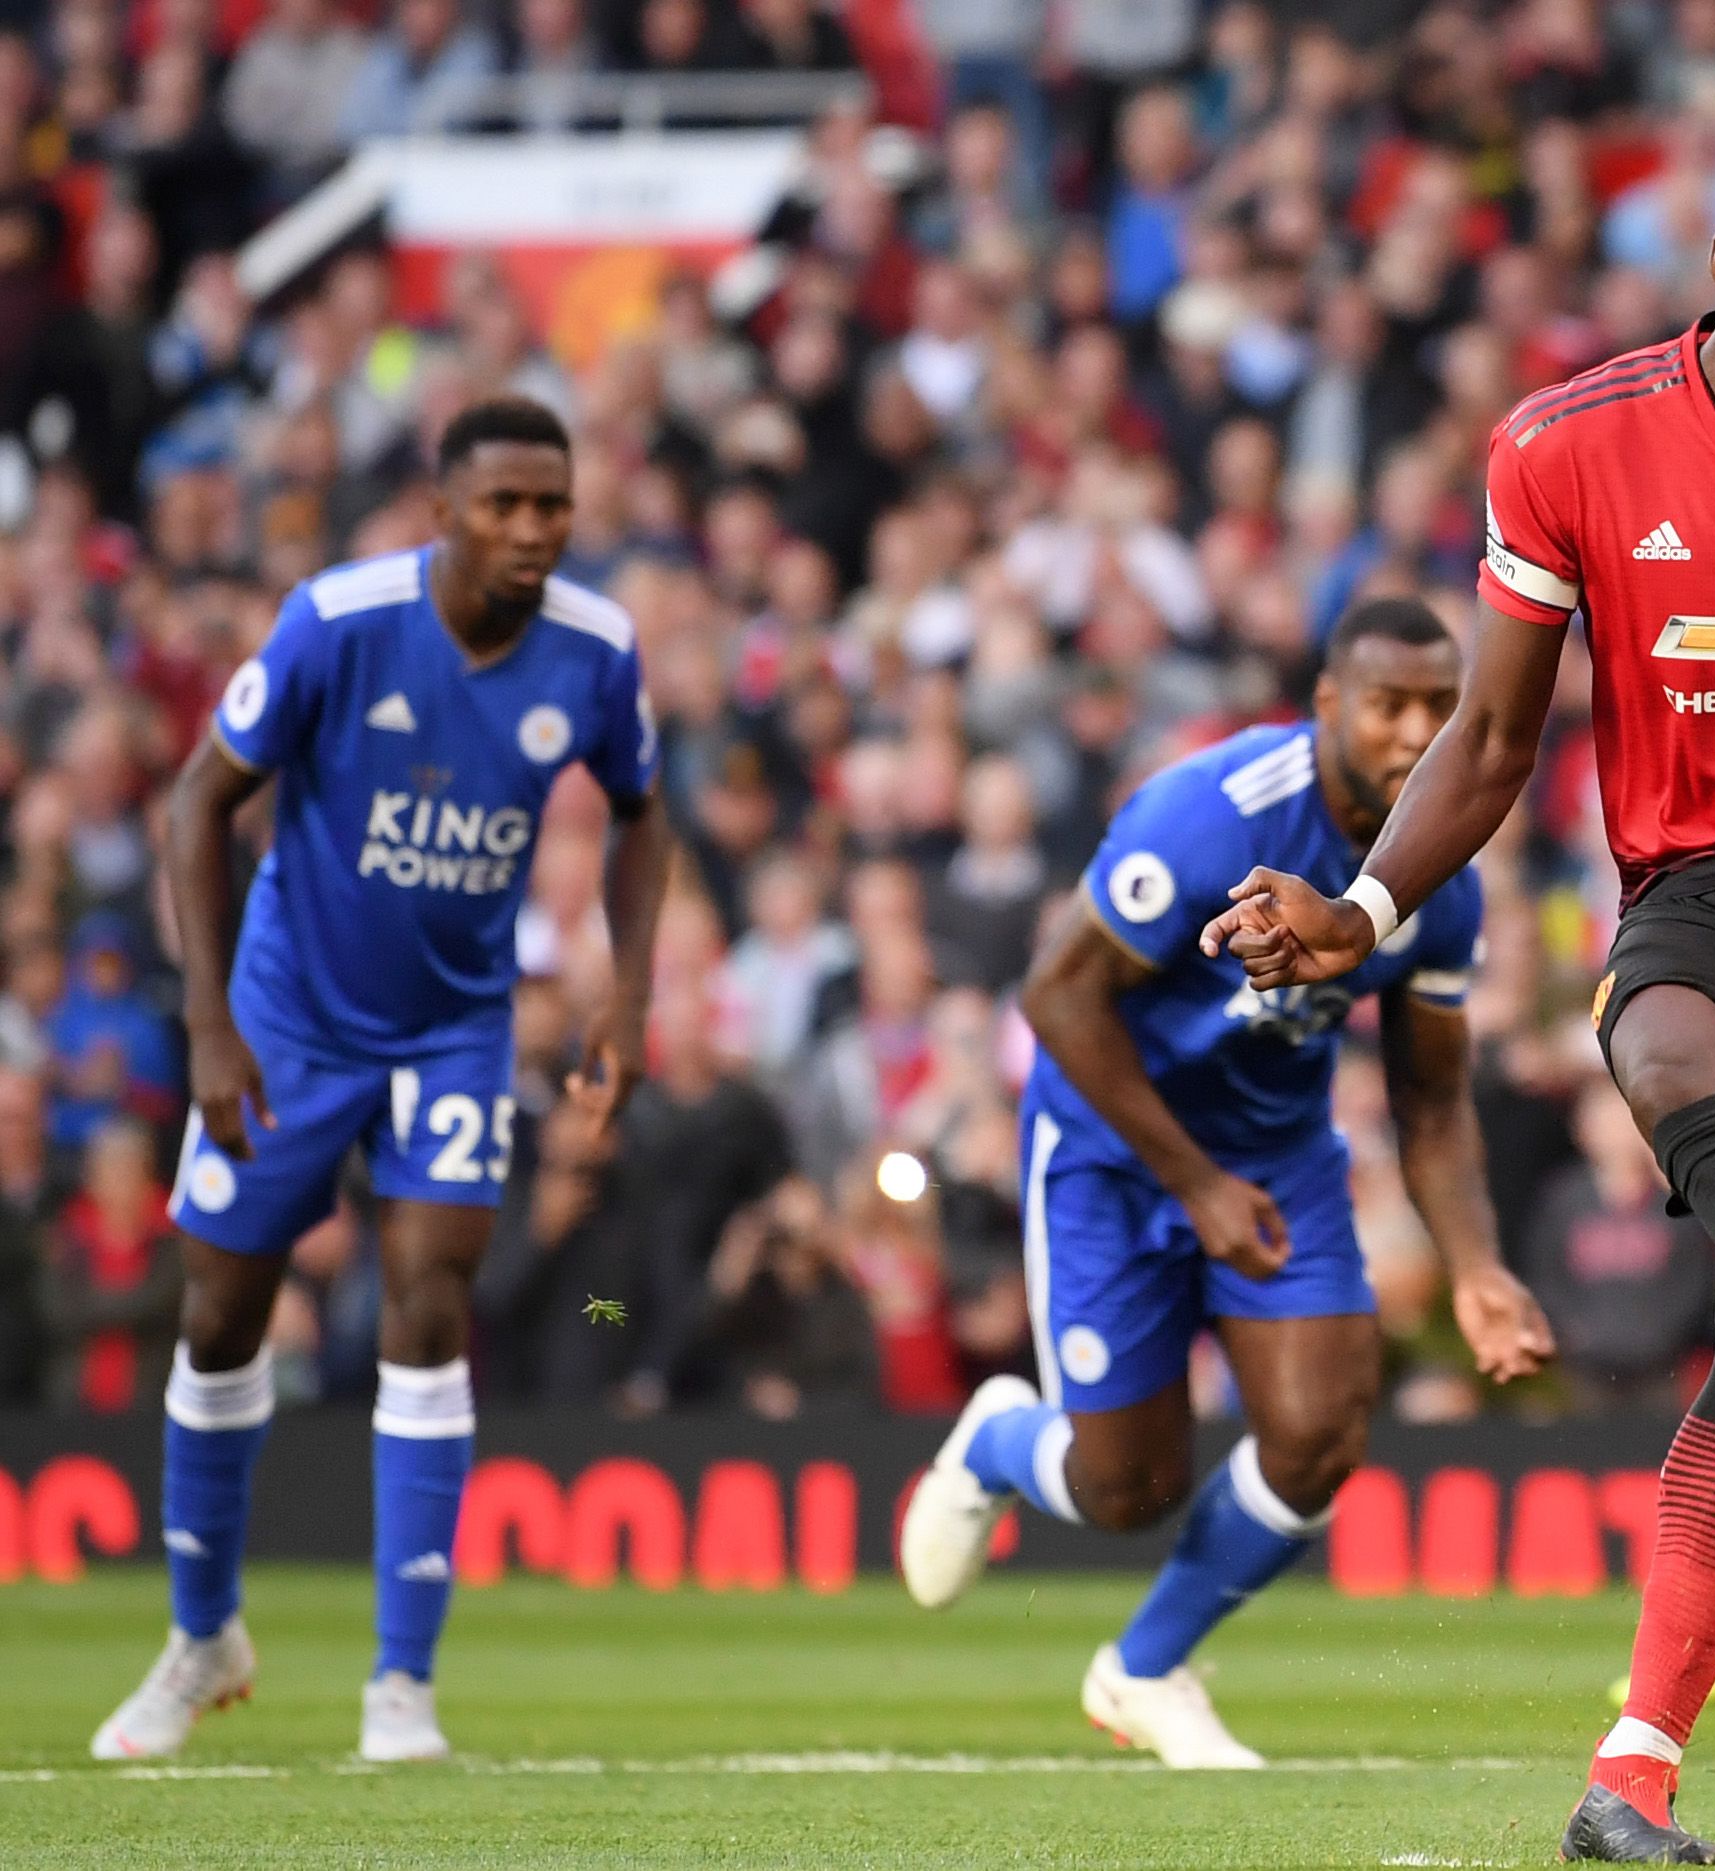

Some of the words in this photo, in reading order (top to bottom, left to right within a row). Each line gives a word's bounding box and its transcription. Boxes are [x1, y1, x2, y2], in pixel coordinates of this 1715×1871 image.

[1632, 546, 1692, 561] adidas
[367, 788, 531, 858] KING
[357, 840, 519, 896] POWER
